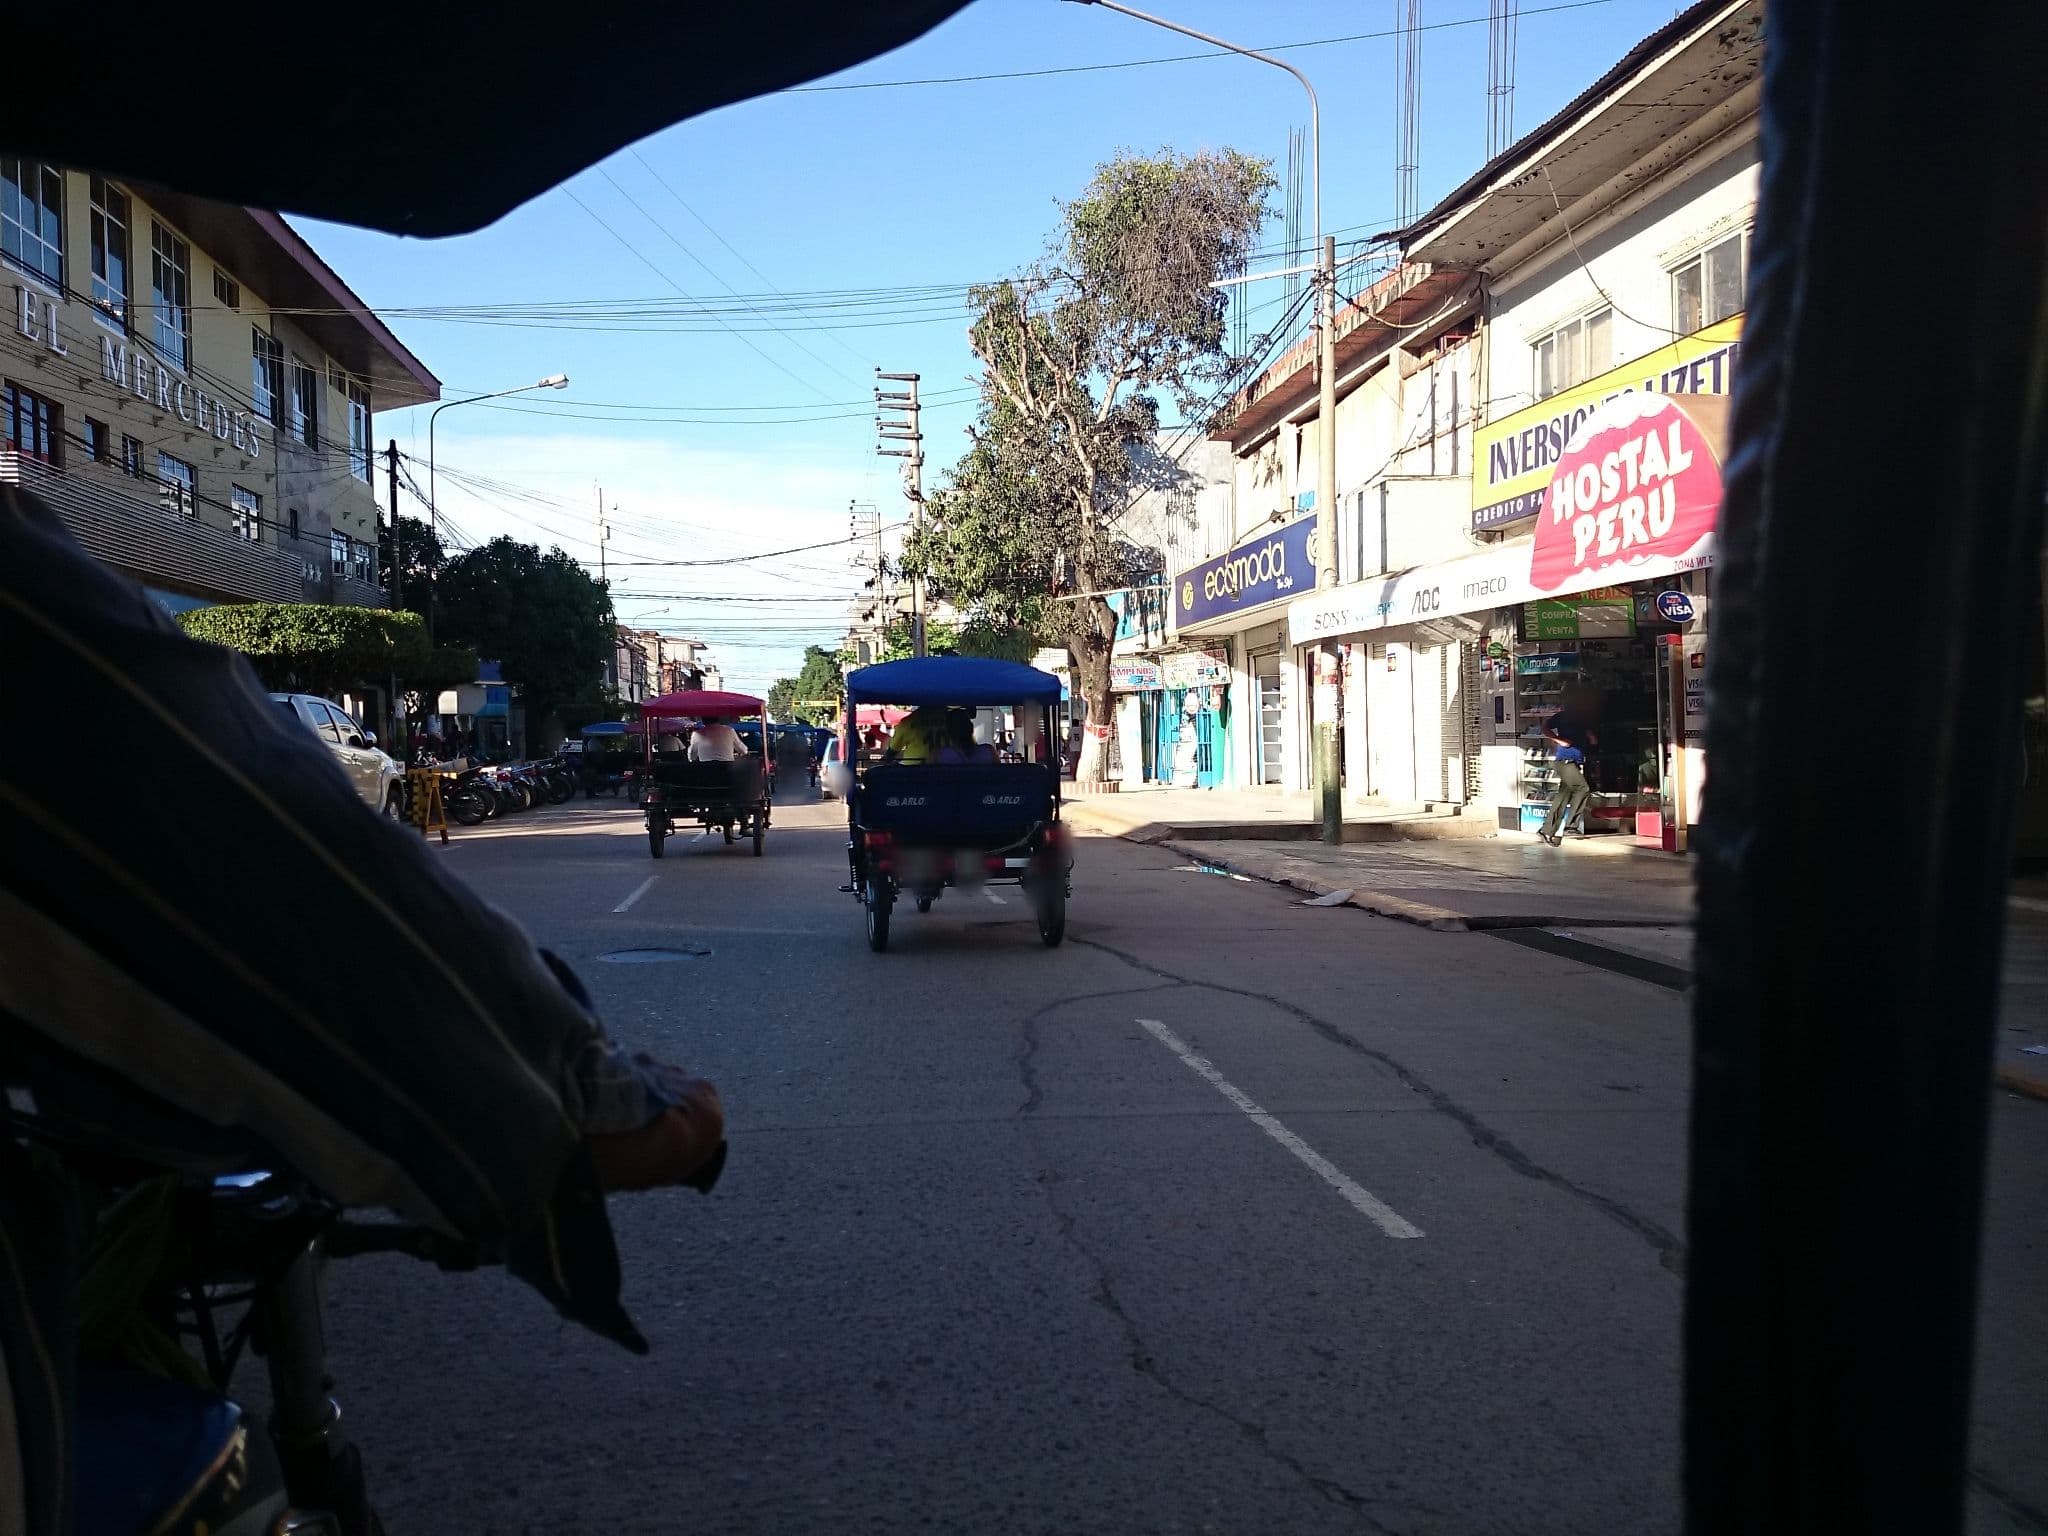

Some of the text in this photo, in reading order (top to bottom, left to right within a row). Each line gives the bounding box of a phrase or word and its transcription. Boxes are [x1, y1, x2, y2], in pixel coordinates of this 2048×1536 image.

[17, 285, 260, 458] EL MERCEDES
[1551, 419, 1693, 526] HOSTAL
[1475, 498, 1524, 525] CREDITO
[1572, 479, 1676, 567] PERU
[1204, 540, 1285, 601] ecomoda
[1674, 557, 1695, 572] ZONA
[1463, 576, 1507, 600] imaco
[1411, 586, 1441, 615] AOC
[1541, 610, 1578, 620] COMPRA
[1664, 605, 1693, 616] VISA
[1546, 626, 1575, 636] VENTA
[1530, 657, 1560, 669] movistar
[901, 797, 925, 807] ARLO
[997, 796, 1021, 805] ARLO
